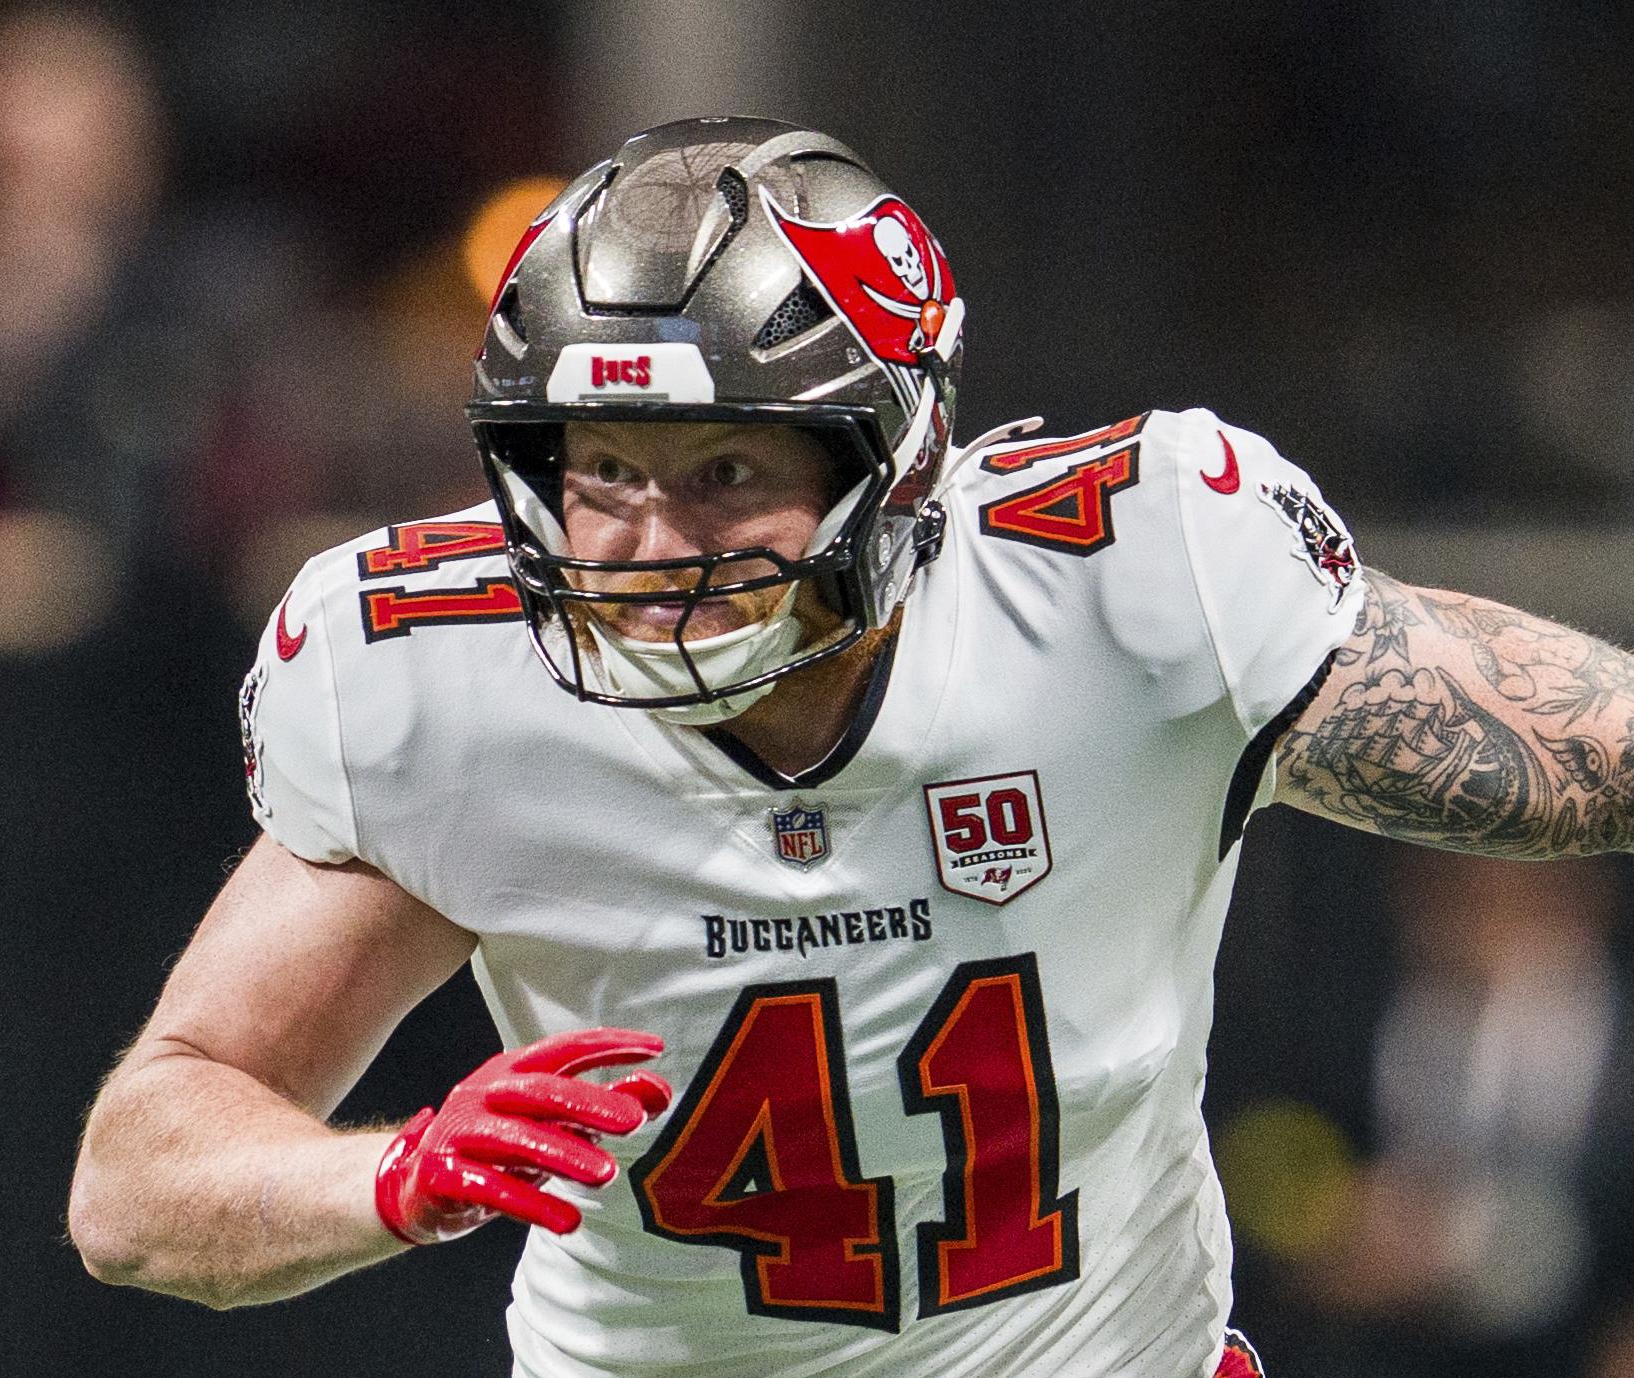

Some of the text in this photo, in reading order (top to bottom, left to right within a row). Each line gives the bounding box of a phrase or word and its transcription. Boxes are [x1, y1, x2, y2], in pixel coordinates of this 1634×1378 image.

[979, 411, 1152, 557] 41
[357, 520, 526, 644] 41
[781, 831, 823, 859] NFL
[938, 788, 1034, 854] 50
[964, 849, 1023, 865] SEASONS
[701, 898, 933, 958] BUCCANEERS
[628, 952, 1080, 1334] 41
